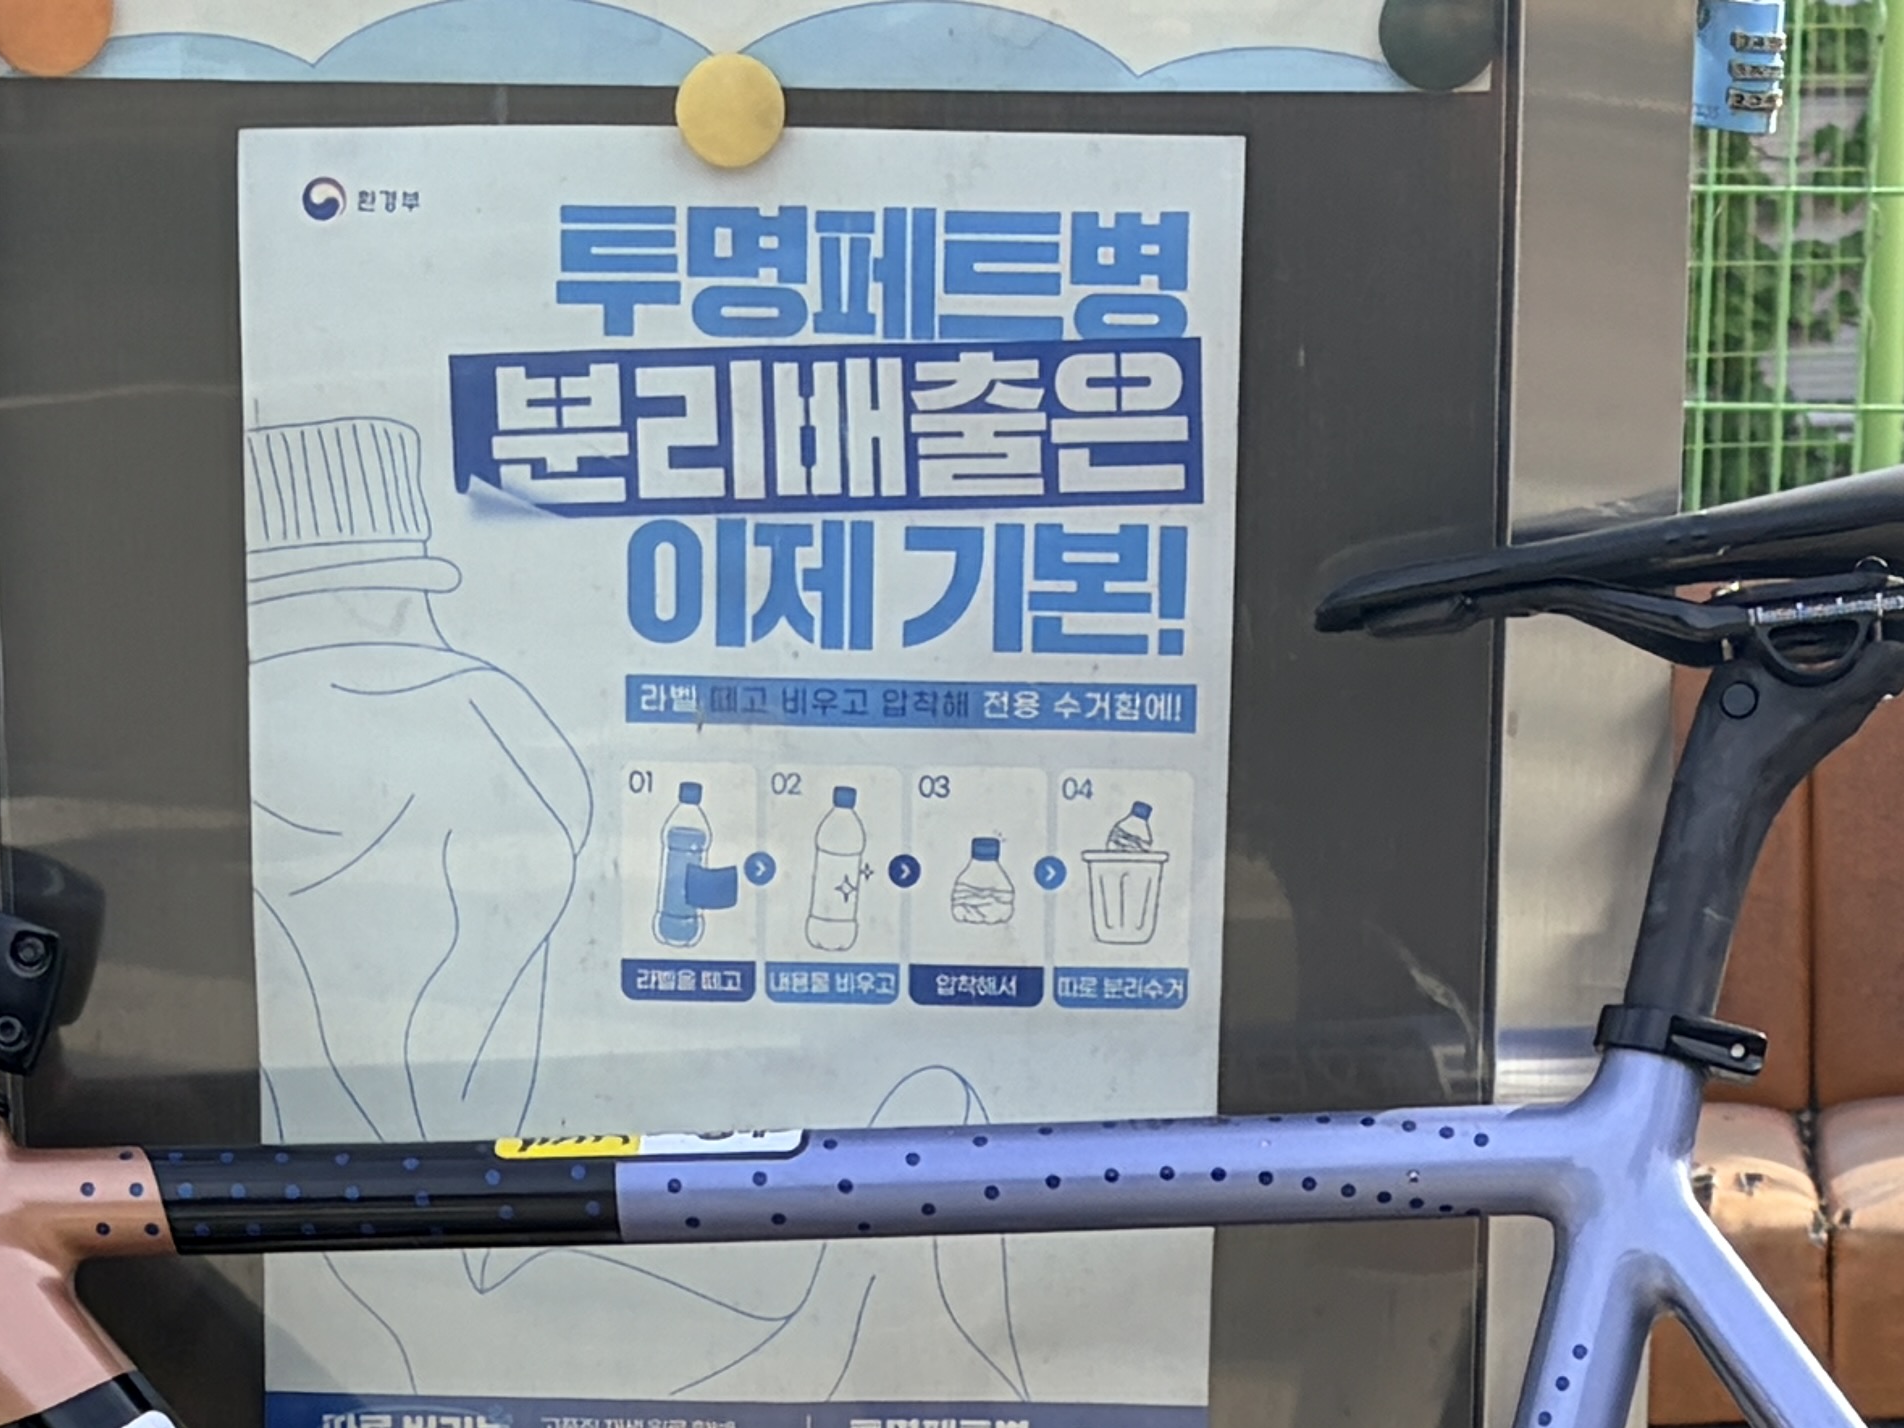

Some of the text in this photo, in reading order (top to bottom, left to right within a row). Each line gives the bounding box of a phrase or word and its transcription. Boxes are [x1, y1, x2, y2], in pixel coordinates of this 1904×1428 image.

[357, 189, 420, 213] 환경부
[555, 205, 1190, 340] 투명페트병
[491, 351, 1189, 502] 분리배출은
[626, 518, 1184, 656] 이제 기본!
[639, 683, 1183, 723] 라벨 떼고 비우고 압착해 전용 수거함에!
[628, 770, 653, 794] 01
[770, 773, 802, 796] 02
[918, 775, 951, 799] 03
[1061, 777, 1094, 800] 04
[636, 968, 696, 992] 라벨을
[835, 971, 896, 995] 비우고
[935, 975, 1017, 997] 압착해서
[1104, 976, 1184, 1000] 분리수거
